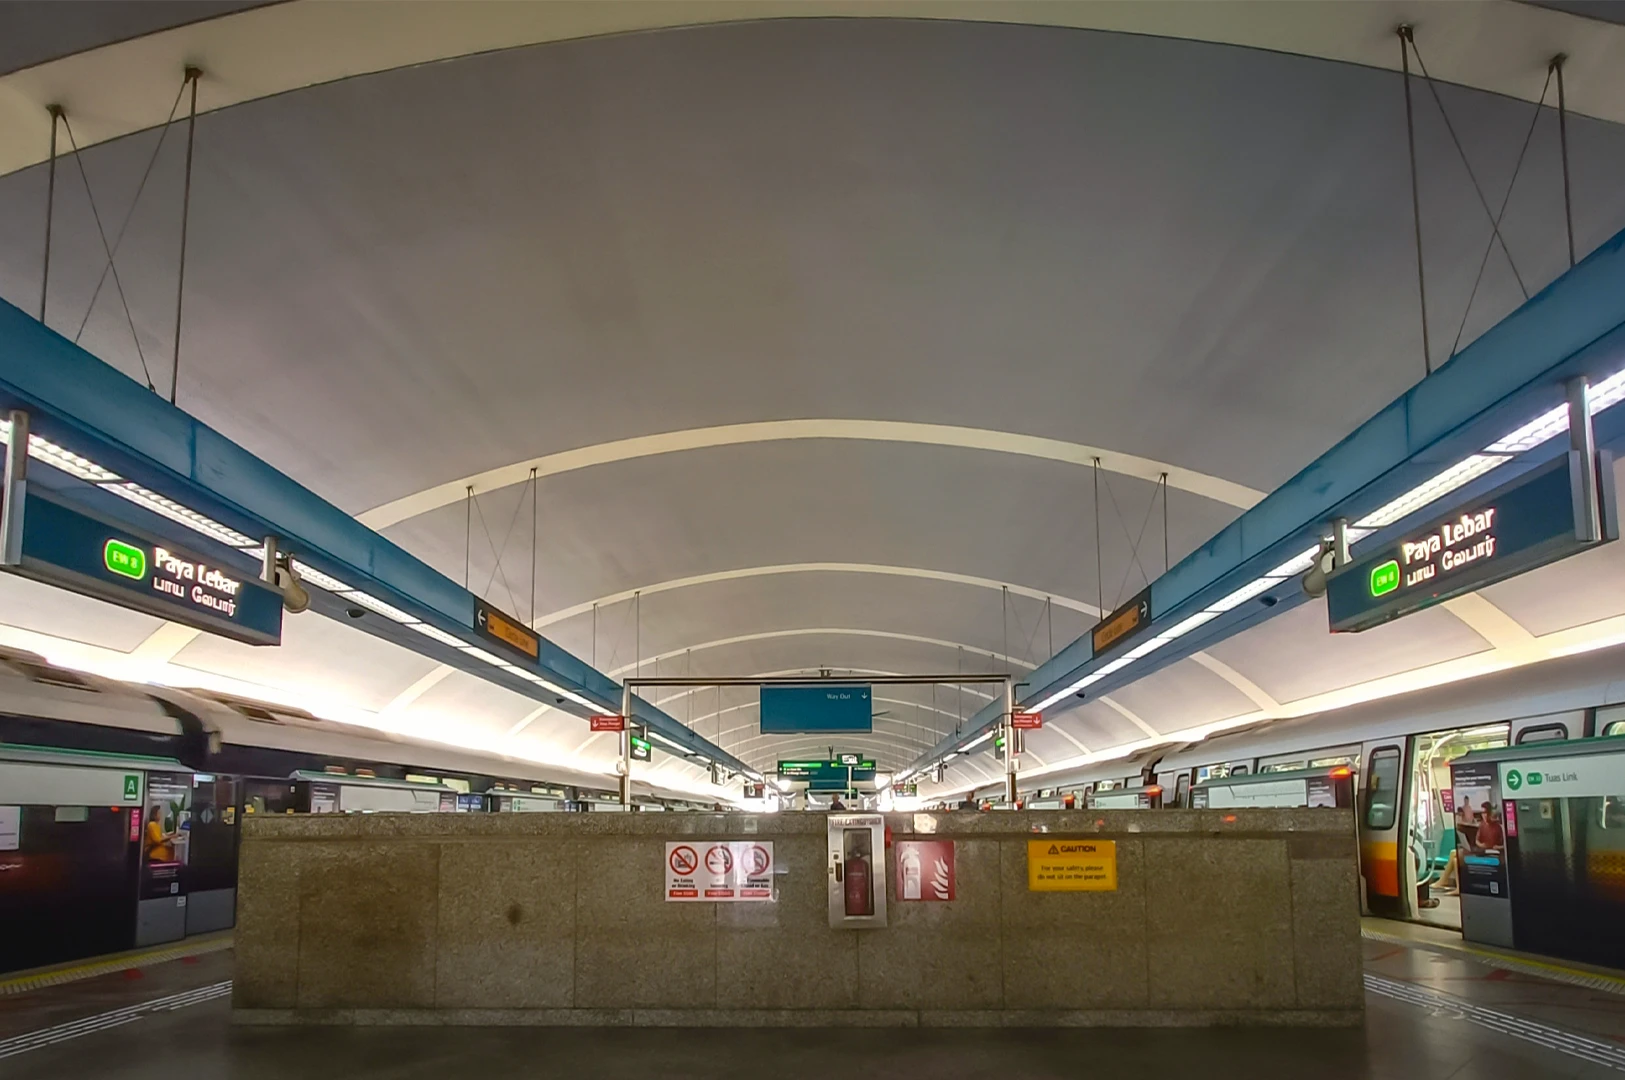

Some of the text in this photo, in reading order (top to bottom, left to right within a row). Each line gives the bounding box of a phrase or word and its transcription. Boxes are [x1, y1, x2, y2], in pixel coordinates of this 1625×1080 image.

[1403, 507, 1497, 565] Paya Lebar
[112, 550, 130, 564] EW
[154, 547, 240, 596] Paya Lebar
[1545, 773, 1561, 782] Tuas
[1563, 772, 1578, 782] Link
[127, 780, 136, 792] A
[1060, 845, 1097, 853] CAUTION
